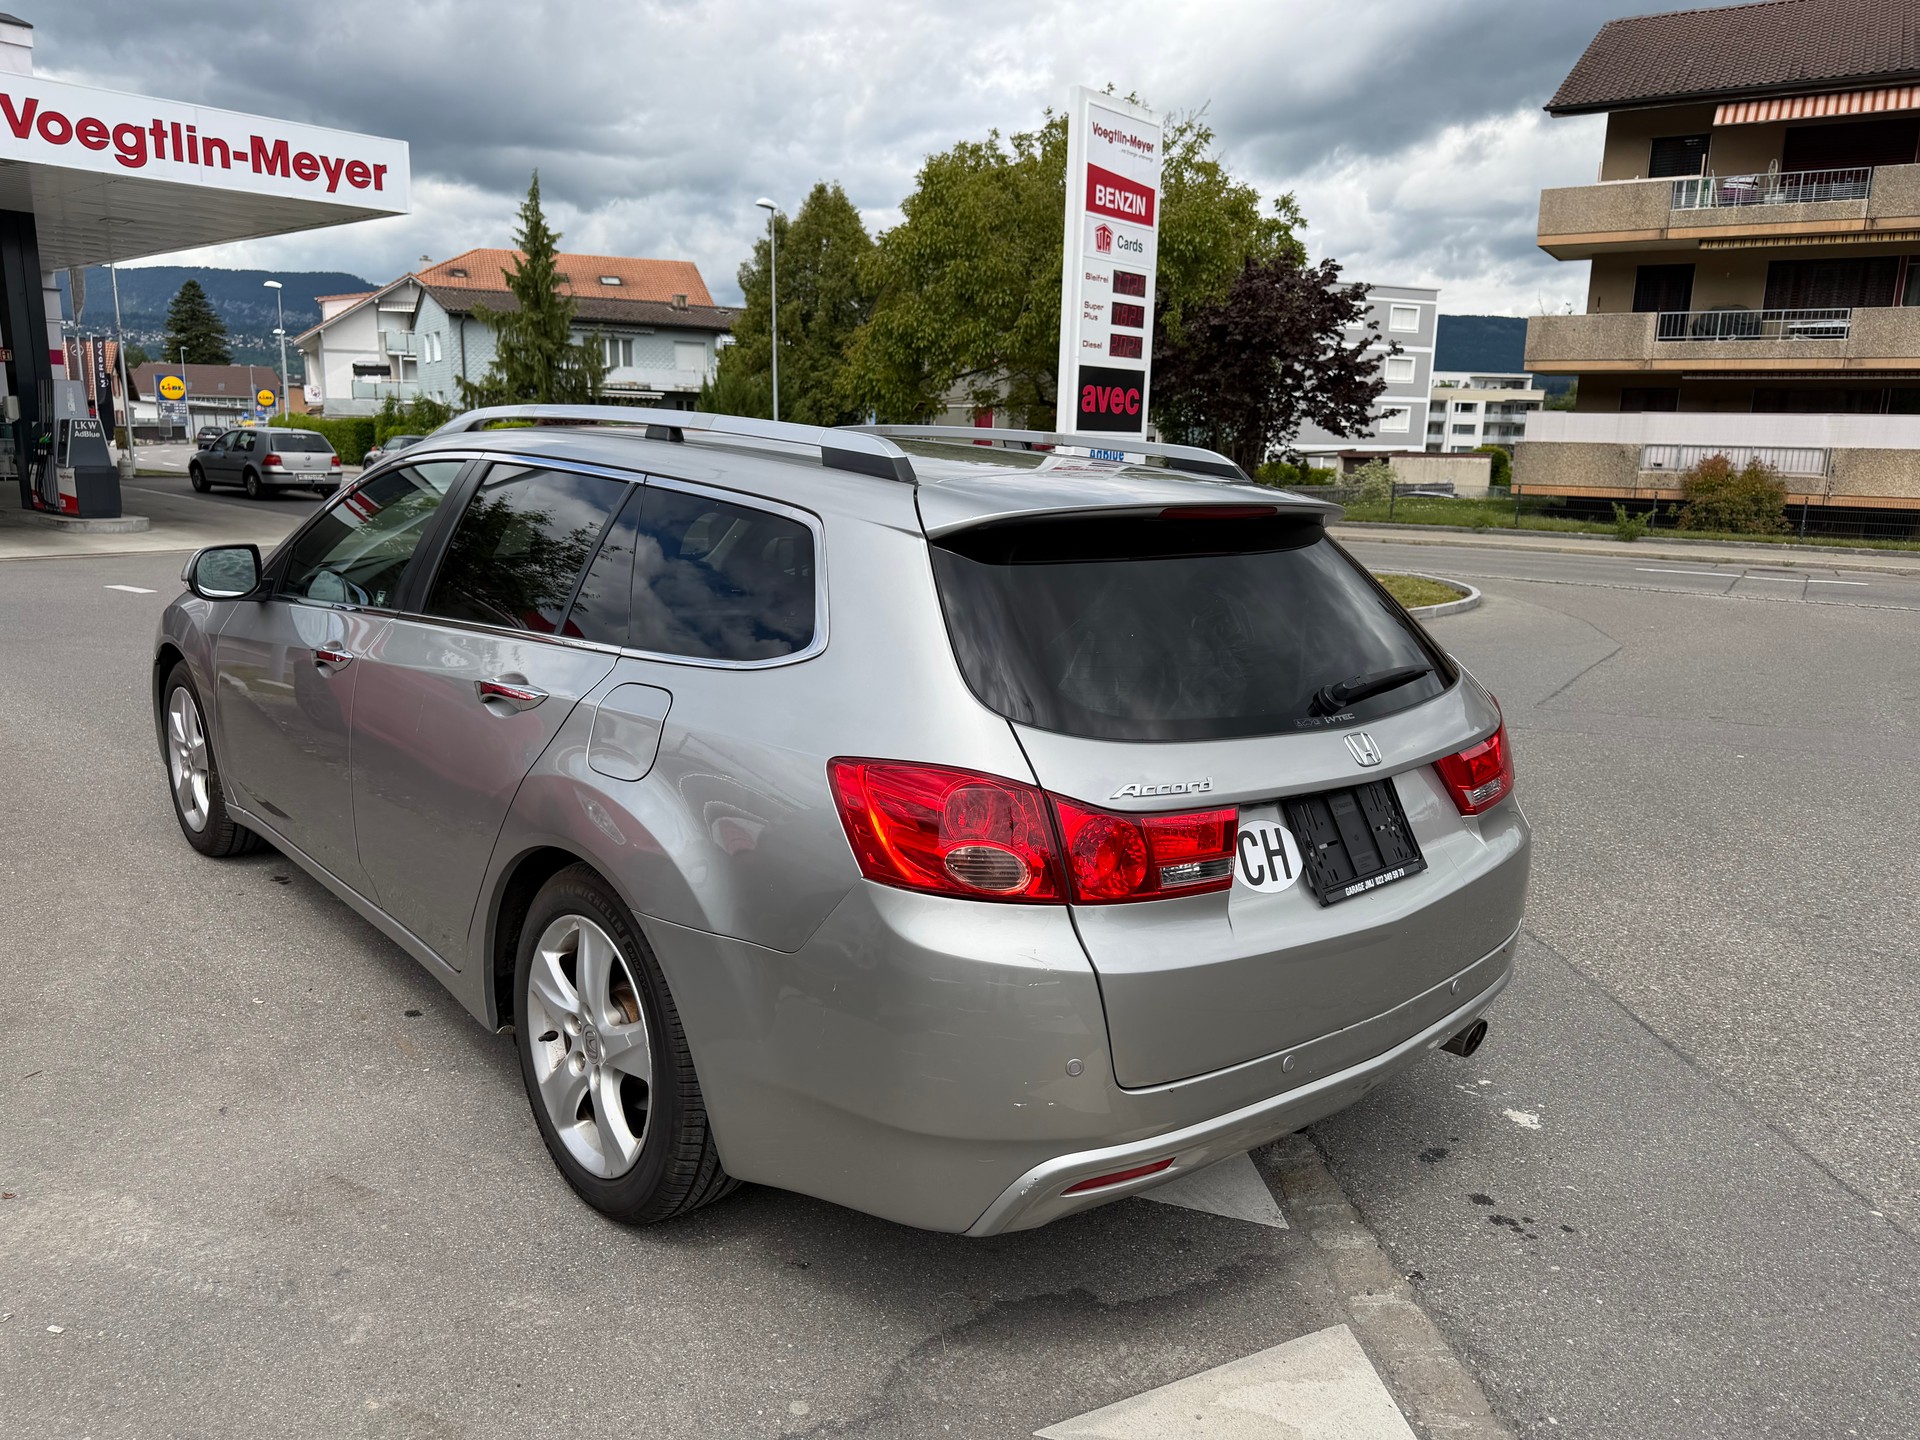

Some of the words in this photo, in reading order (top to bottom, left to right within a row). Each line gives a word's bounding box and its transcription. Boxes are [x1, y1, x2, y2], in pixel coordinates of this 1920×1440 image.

[0, 93, 388, 193] Voegtlin-Meyer
[1092, 121, 1154, 153] Voegtlin-Meyer
[1095, 184, 1146, 217] BENZIN
[1117, 235, 1143, 253] Cards
[1085, 272, 1109, 284] Bleifrei
[1083, 312, 1098, 321] Plus
[1084, 301, 1104, 312] Super
[1082, 340, 1103, 349] Diesel
[1081, 385, 1140, 415] avec
[74, 421, 97, 430] LKW
[74, 430, 100, 438] AdBlue
[1109, 777, 1214, 799] Accord
[1237, 827, 1293, 886] CH
[1345, 882, 1366, 896] GARAGE
[1365, 879, 1375, 889] JMJ
[1375, 875, 1384, 885] 022
[1383, 872, 1393, 882] 349
[1398, 868, 1405, 877] 79
[574, 886, 625, 934] MICHELIN
